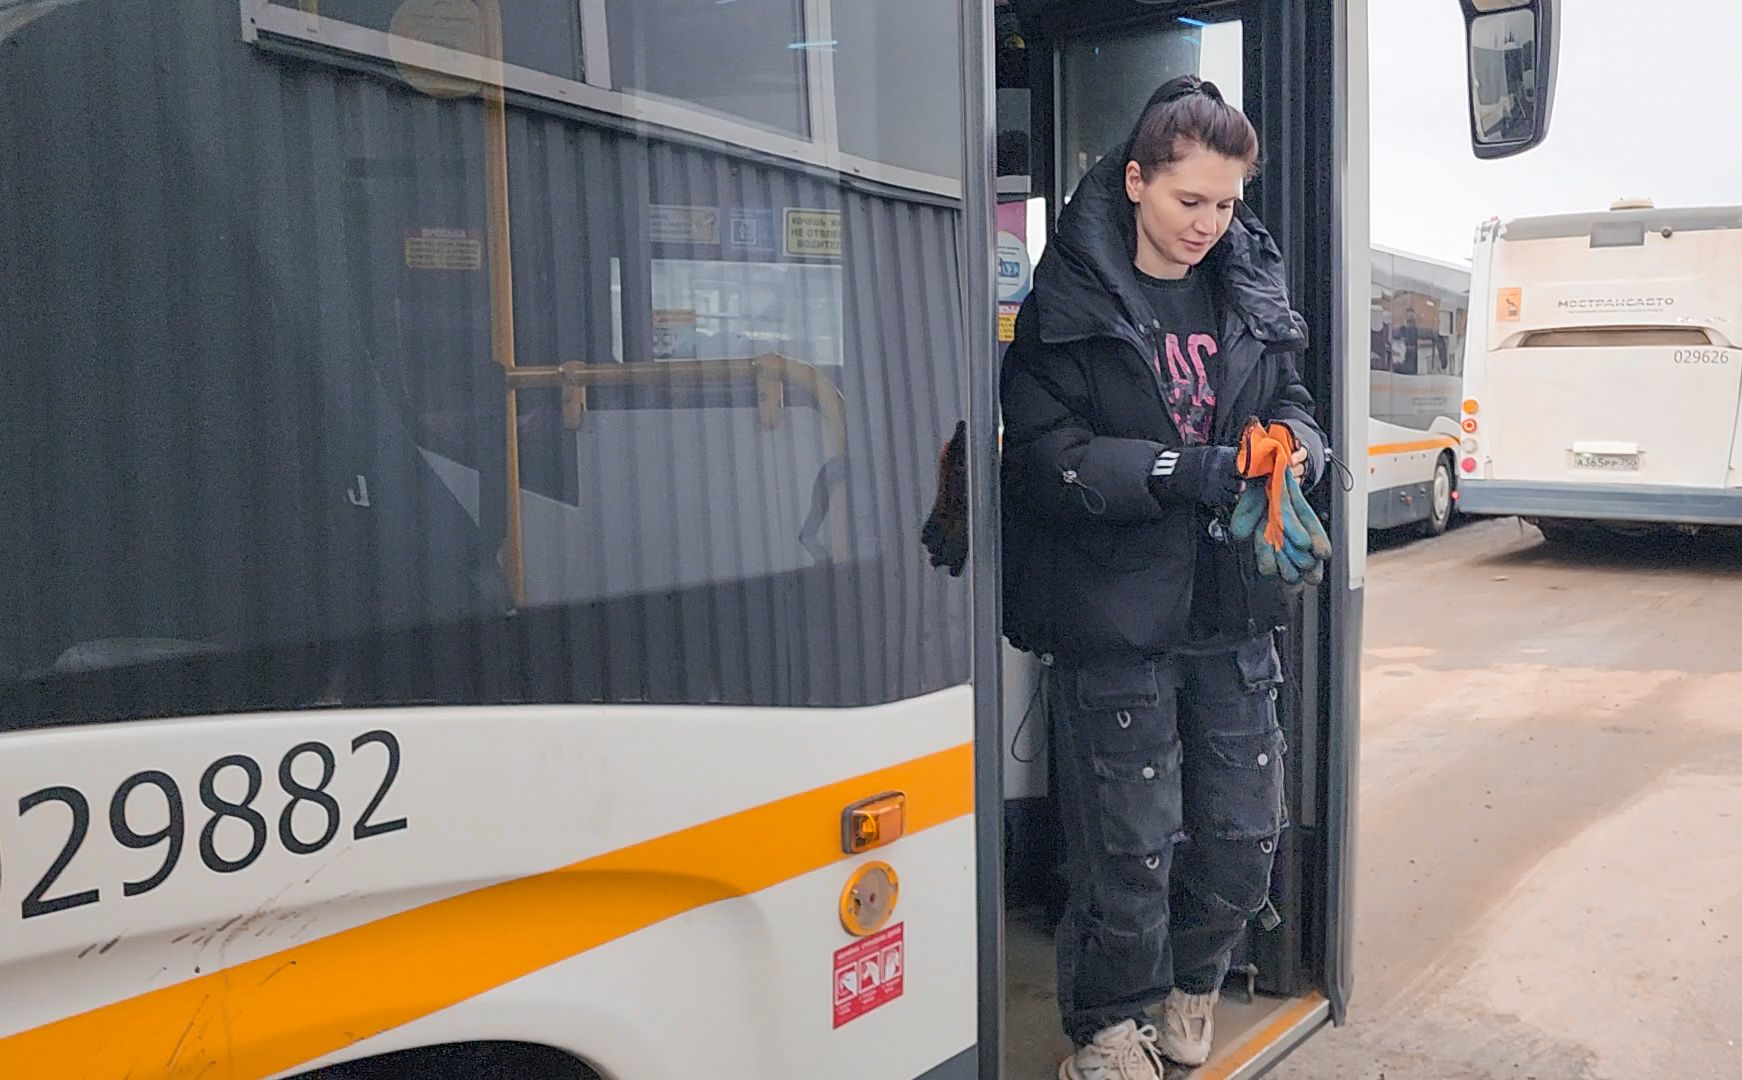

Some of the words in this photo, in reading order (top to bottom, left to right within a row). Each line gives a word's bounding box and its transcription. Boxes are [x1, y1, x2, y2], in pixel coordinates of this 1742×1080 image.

[791, 228, 805, 238] НЕ
[1557, 297, 1675, 310] МОСТРАНСАВТО
[1673, 349, 1729, 364] 029626
[0, 729, 409, 920] 29882
